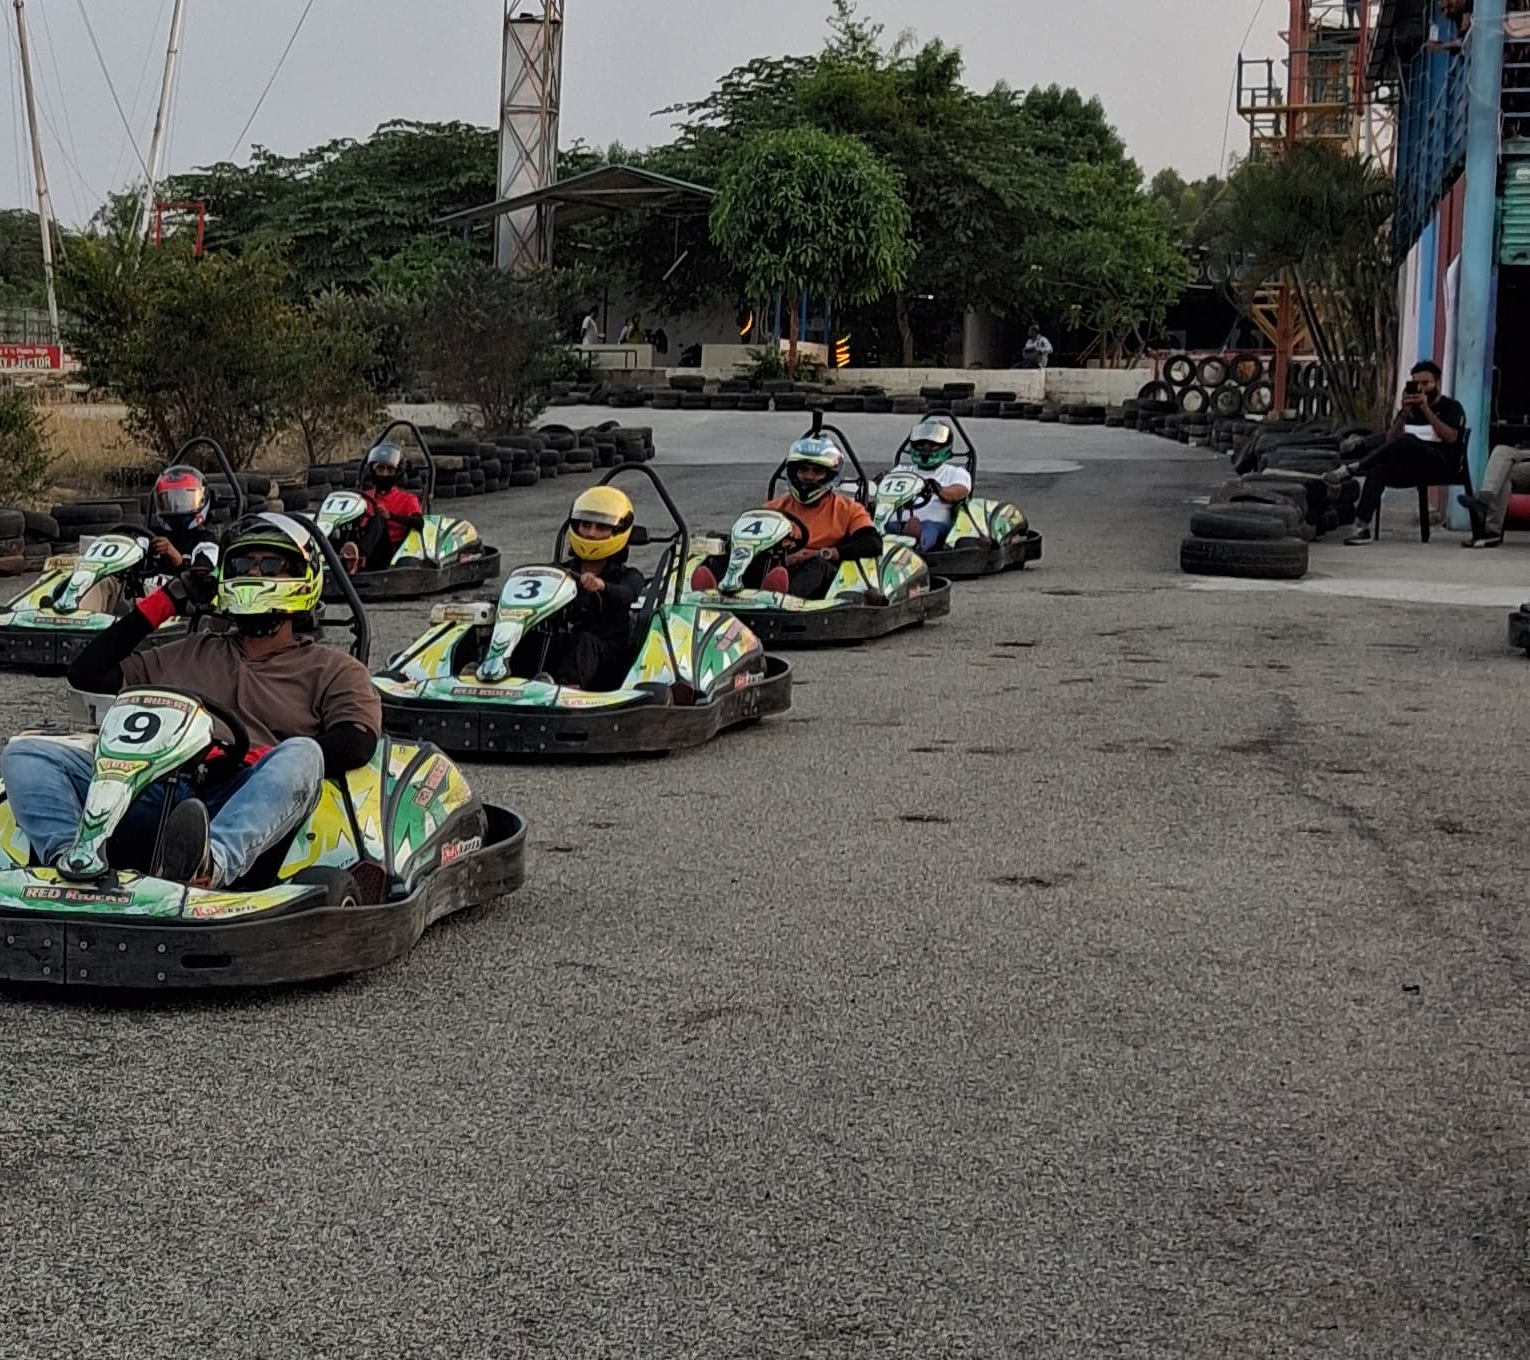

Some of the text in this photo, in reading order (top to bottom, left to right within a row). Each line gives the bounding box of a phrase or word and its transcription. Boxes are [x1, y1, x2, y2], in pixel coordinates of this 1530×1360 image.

[884, 480, 907, 493] 15
[324, 498, 350, 511] 11
[741, 520, 763, 536] 4
[89, 544, 120, 558] 10
[513, 579, 542, 600] 3
[118, 711, 162, 744] 9
[25, 887, 61, 899] RED
